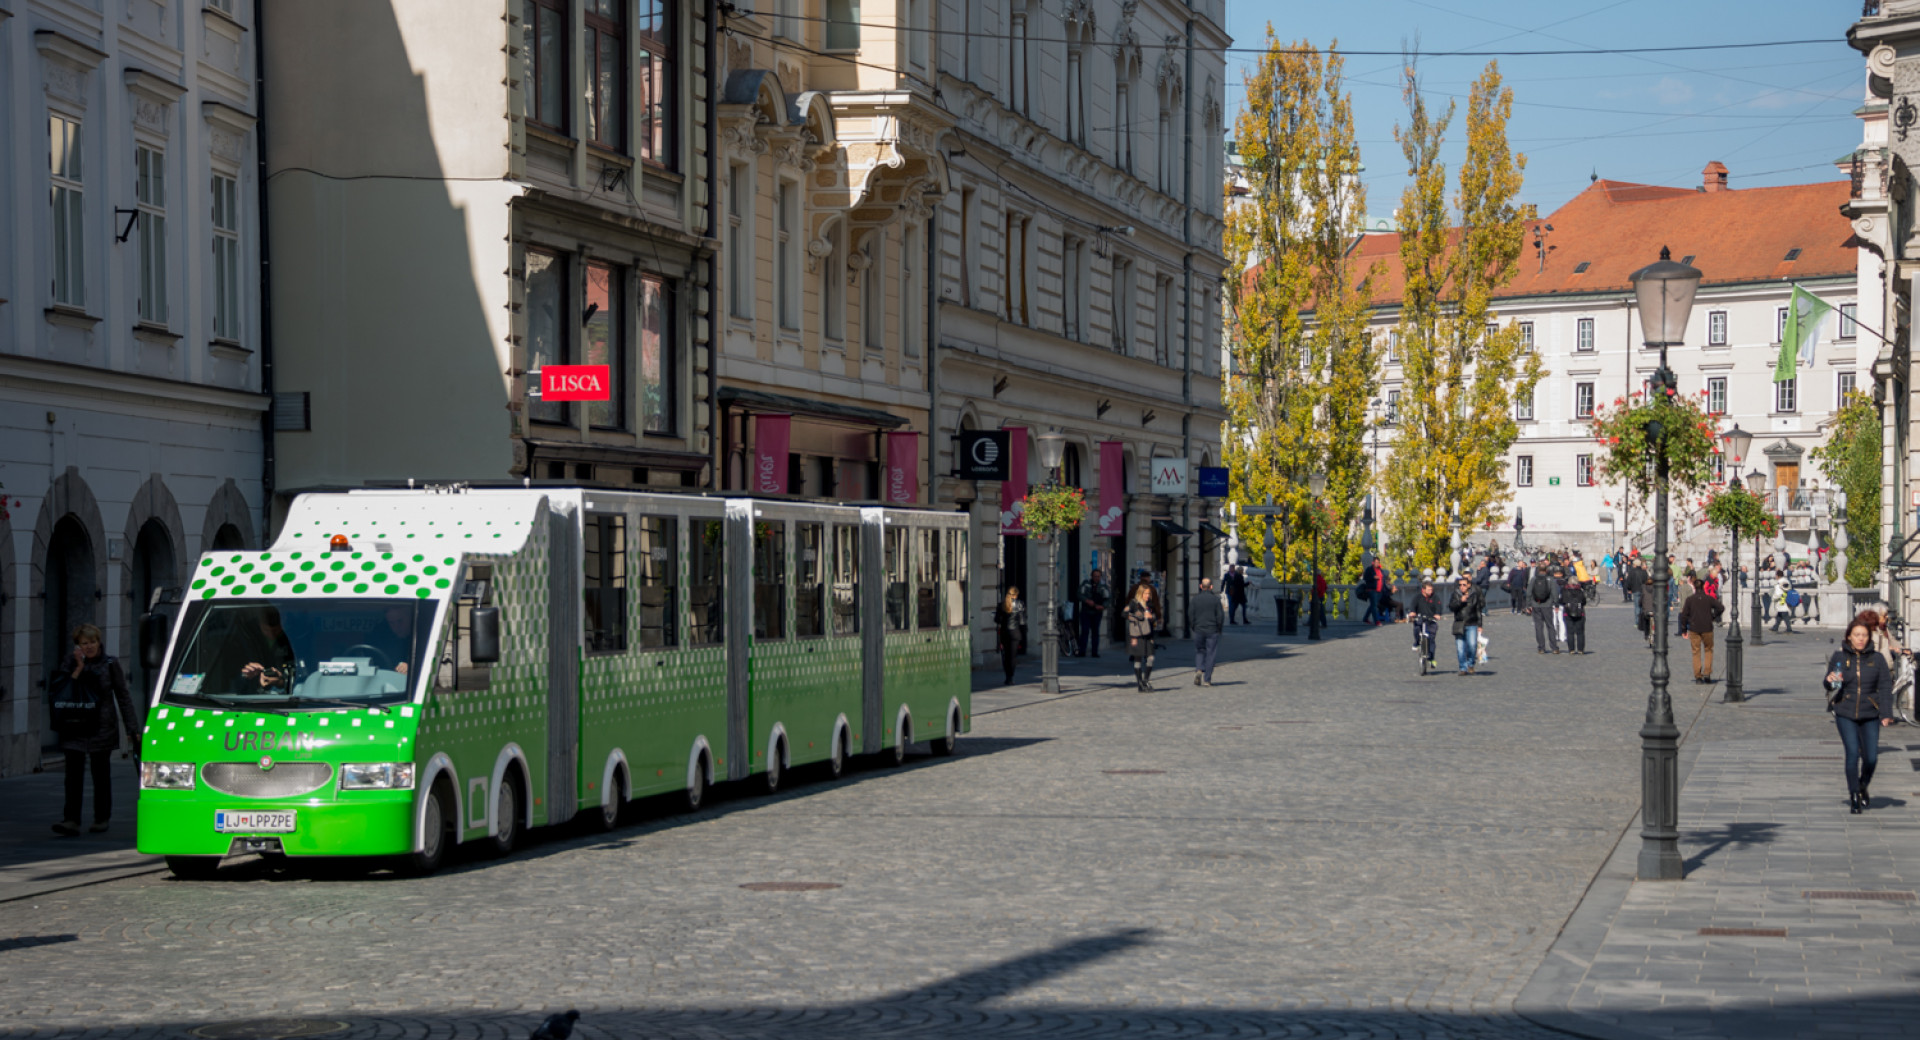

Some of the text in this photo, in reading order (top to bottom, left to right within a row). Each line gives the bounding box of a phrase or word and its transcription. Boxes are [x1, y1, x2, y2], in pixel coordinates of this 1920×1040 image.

[549, 374, 602, 392] LISCA
[223, 730, 315, 752] URBAN
[226, 814, 292, 828] LJ LPPZPE
